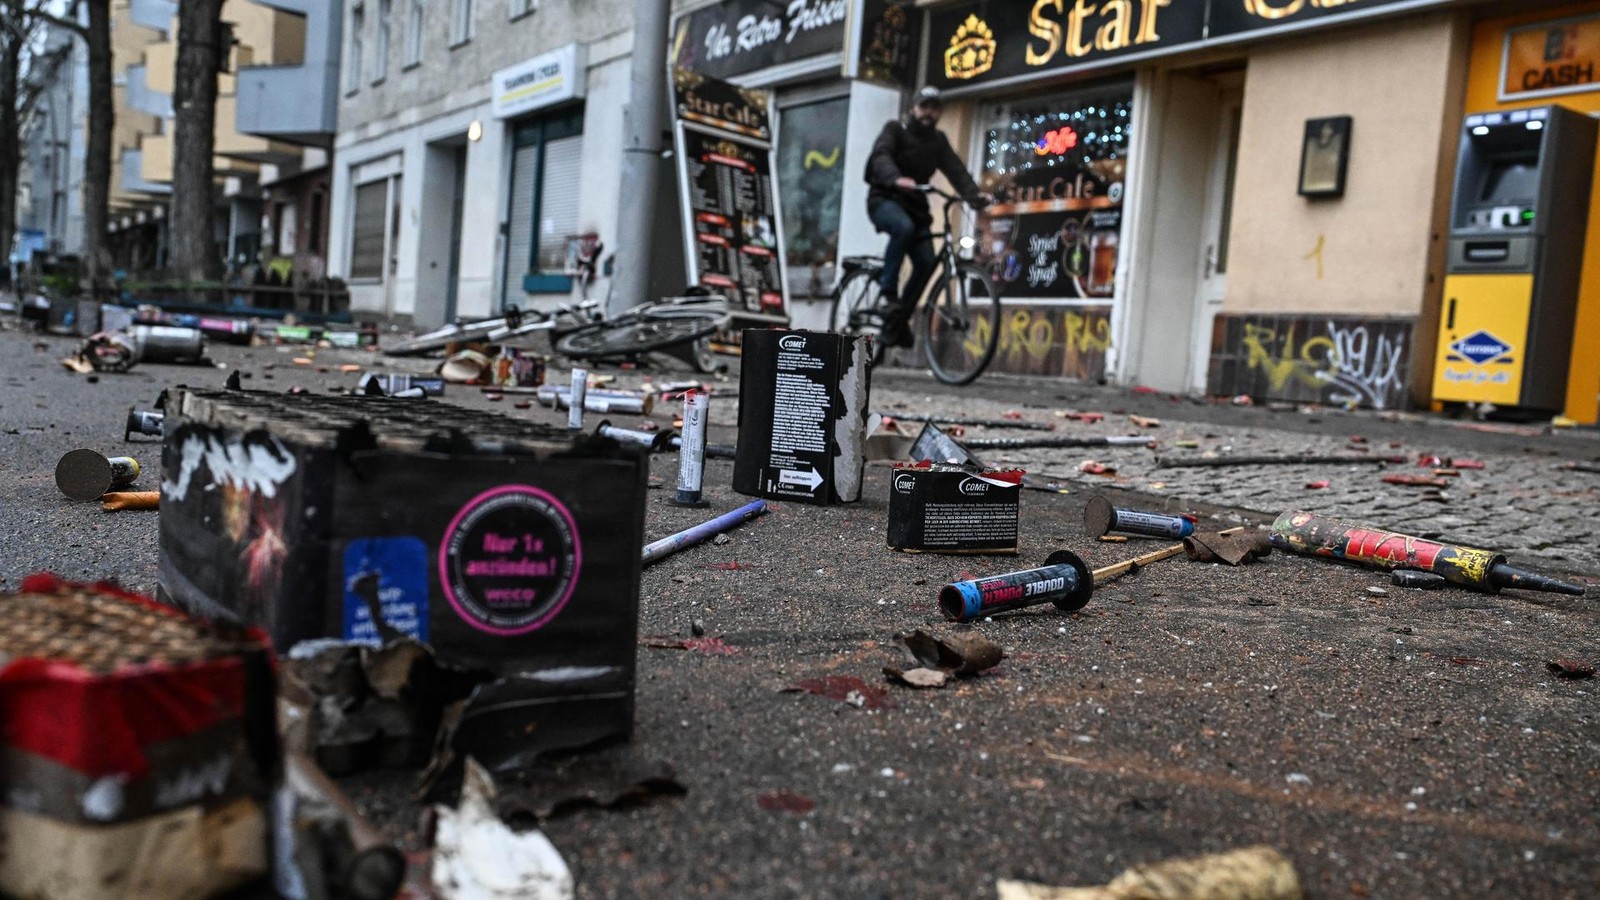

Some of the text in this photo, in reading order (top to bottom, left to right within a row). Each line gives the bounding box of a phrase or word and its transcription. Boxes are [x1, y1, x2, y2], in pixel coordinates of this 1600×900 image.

[1026, 0, 1172, 66] Star
[1522, 62, 1593, 90] CASH
[784, 340, 807, 349] COMET
[898, 480, 916, 490] COMET
[965, 483, 990, 491] COMET
[483, 532, 518, 553] Nur
[984, 577, 1064, 604] DOUBLE POWER
